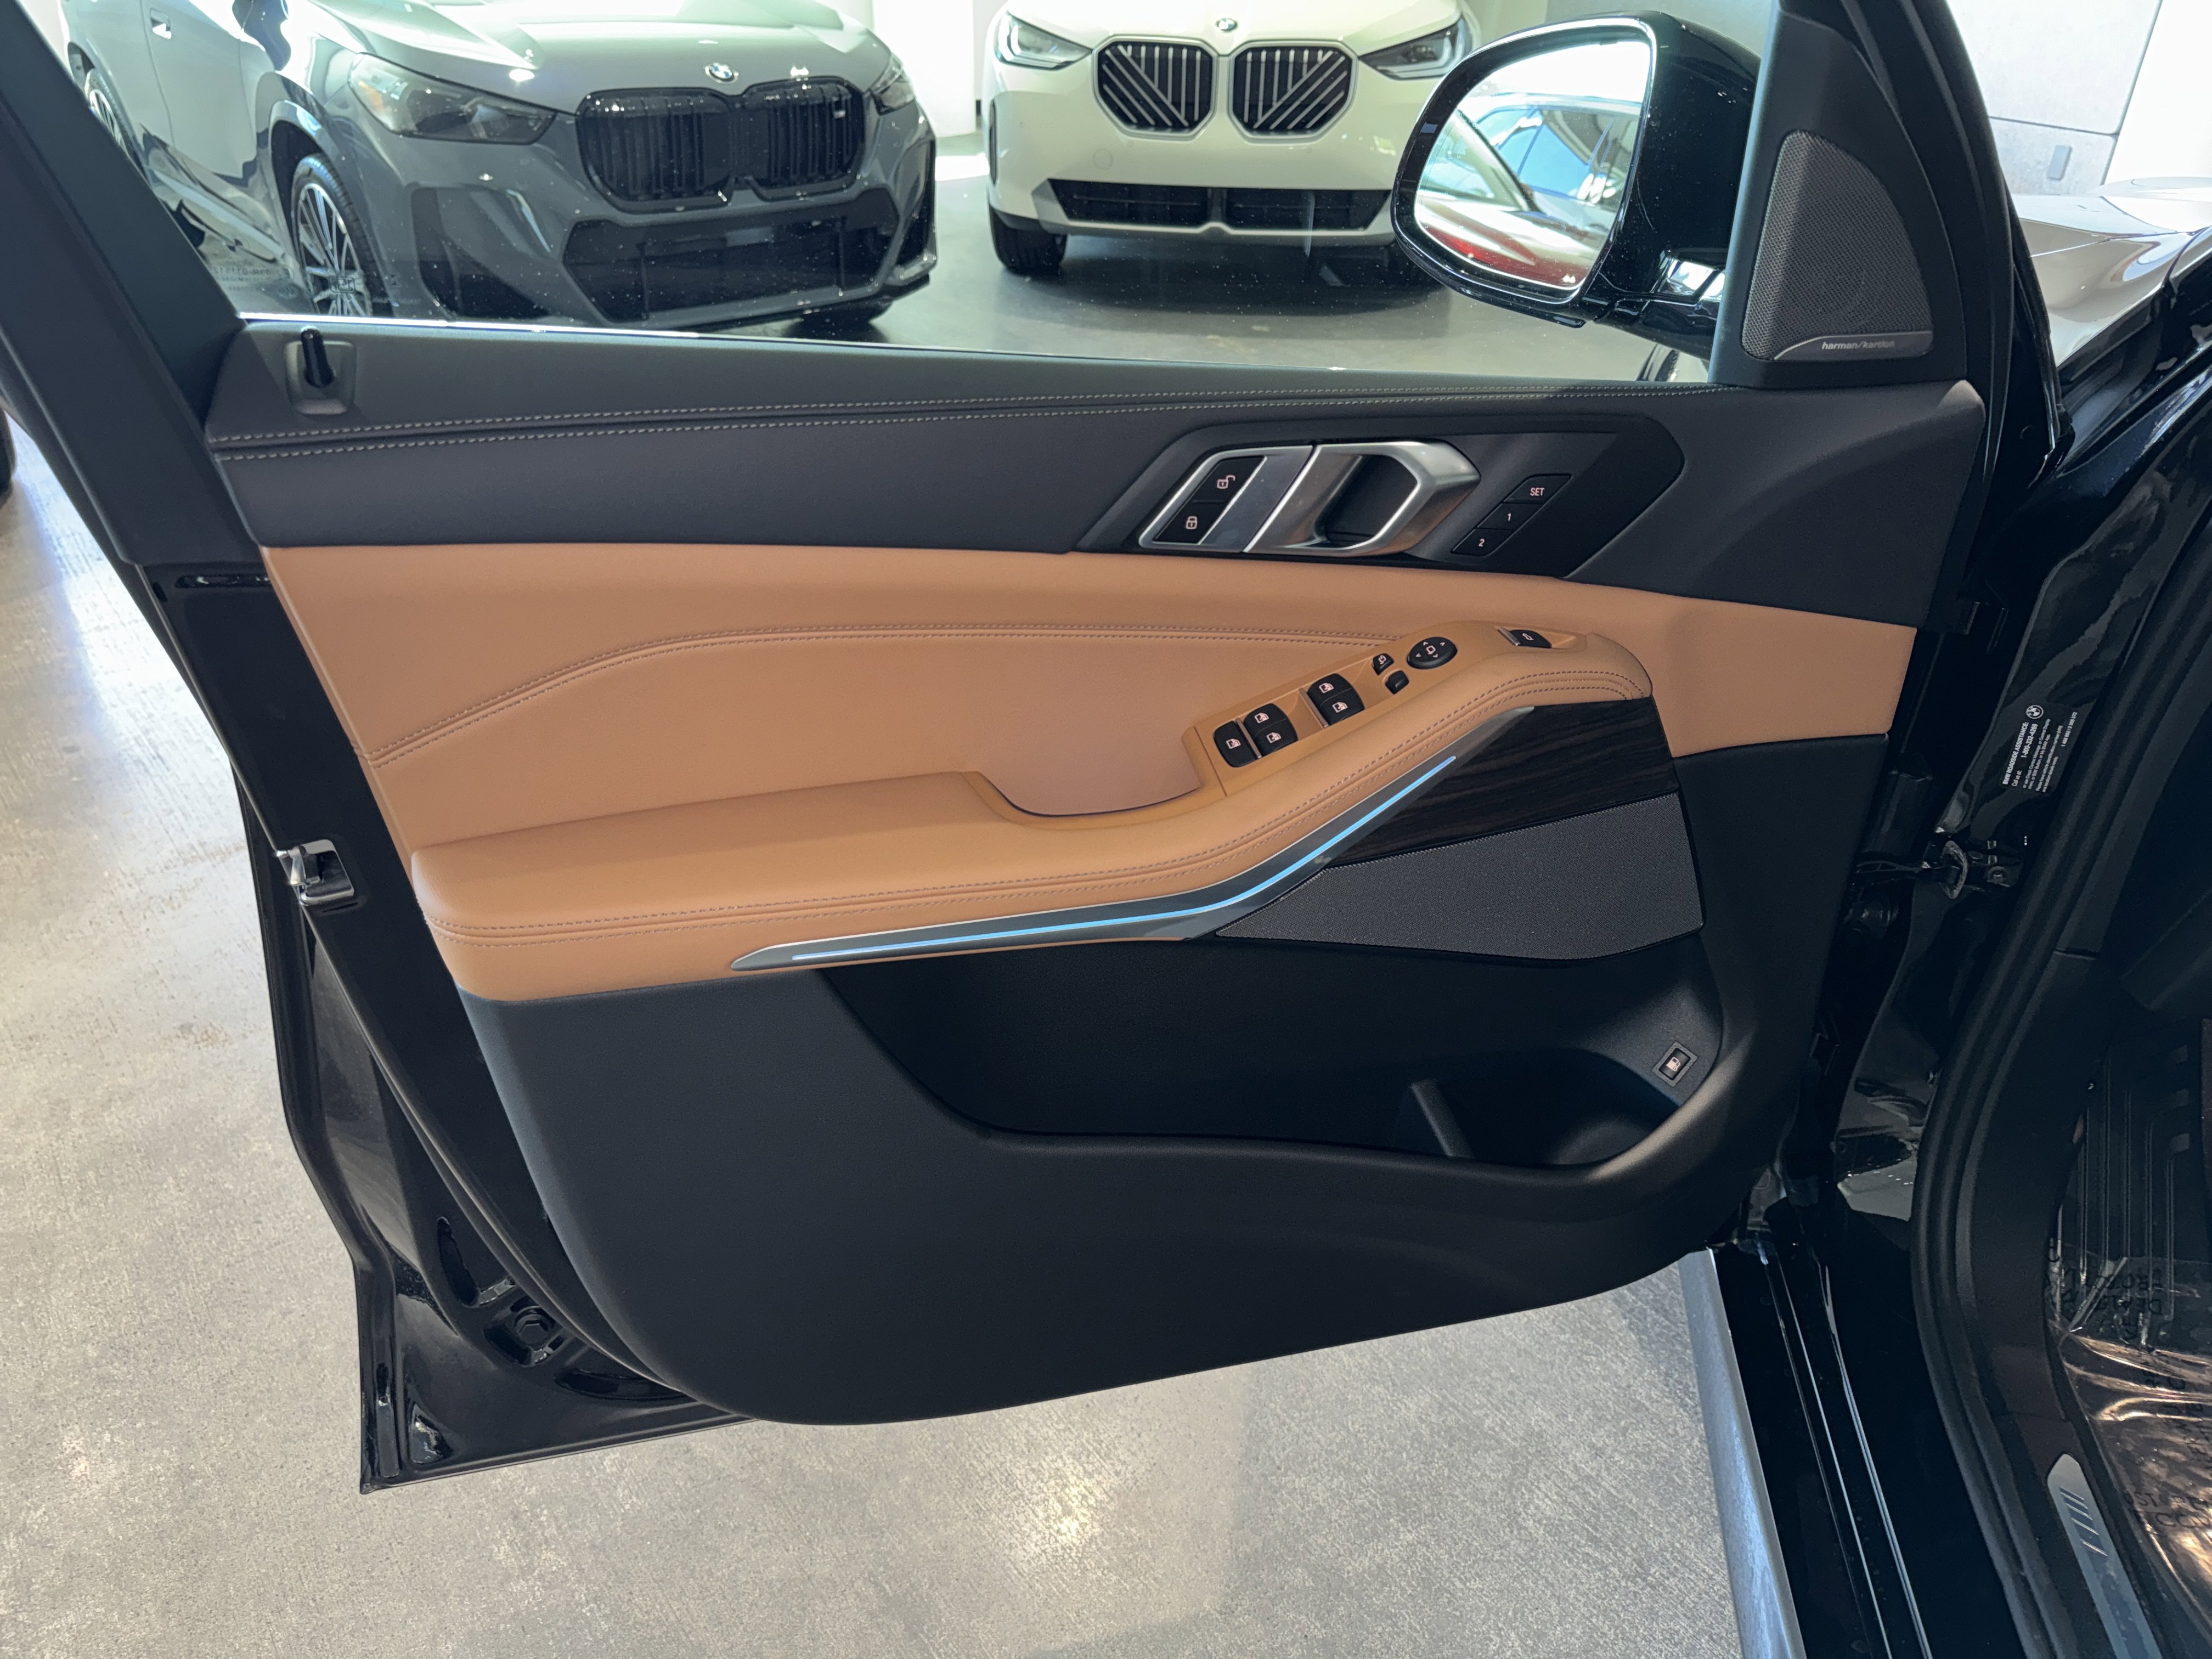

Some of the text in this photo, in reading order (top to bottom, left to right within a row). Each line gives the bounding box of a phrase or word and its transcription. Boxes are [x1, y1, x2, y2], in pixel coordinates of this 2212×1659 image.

[1530, 488, 1545, 496] SET
[1507, 513, 1511, 521] 1
[1478, 539, 1485, 547] 2
[2005, 750, 2019, 774] ROADSIDE
[2001, 772, 2011, 785] BMW
